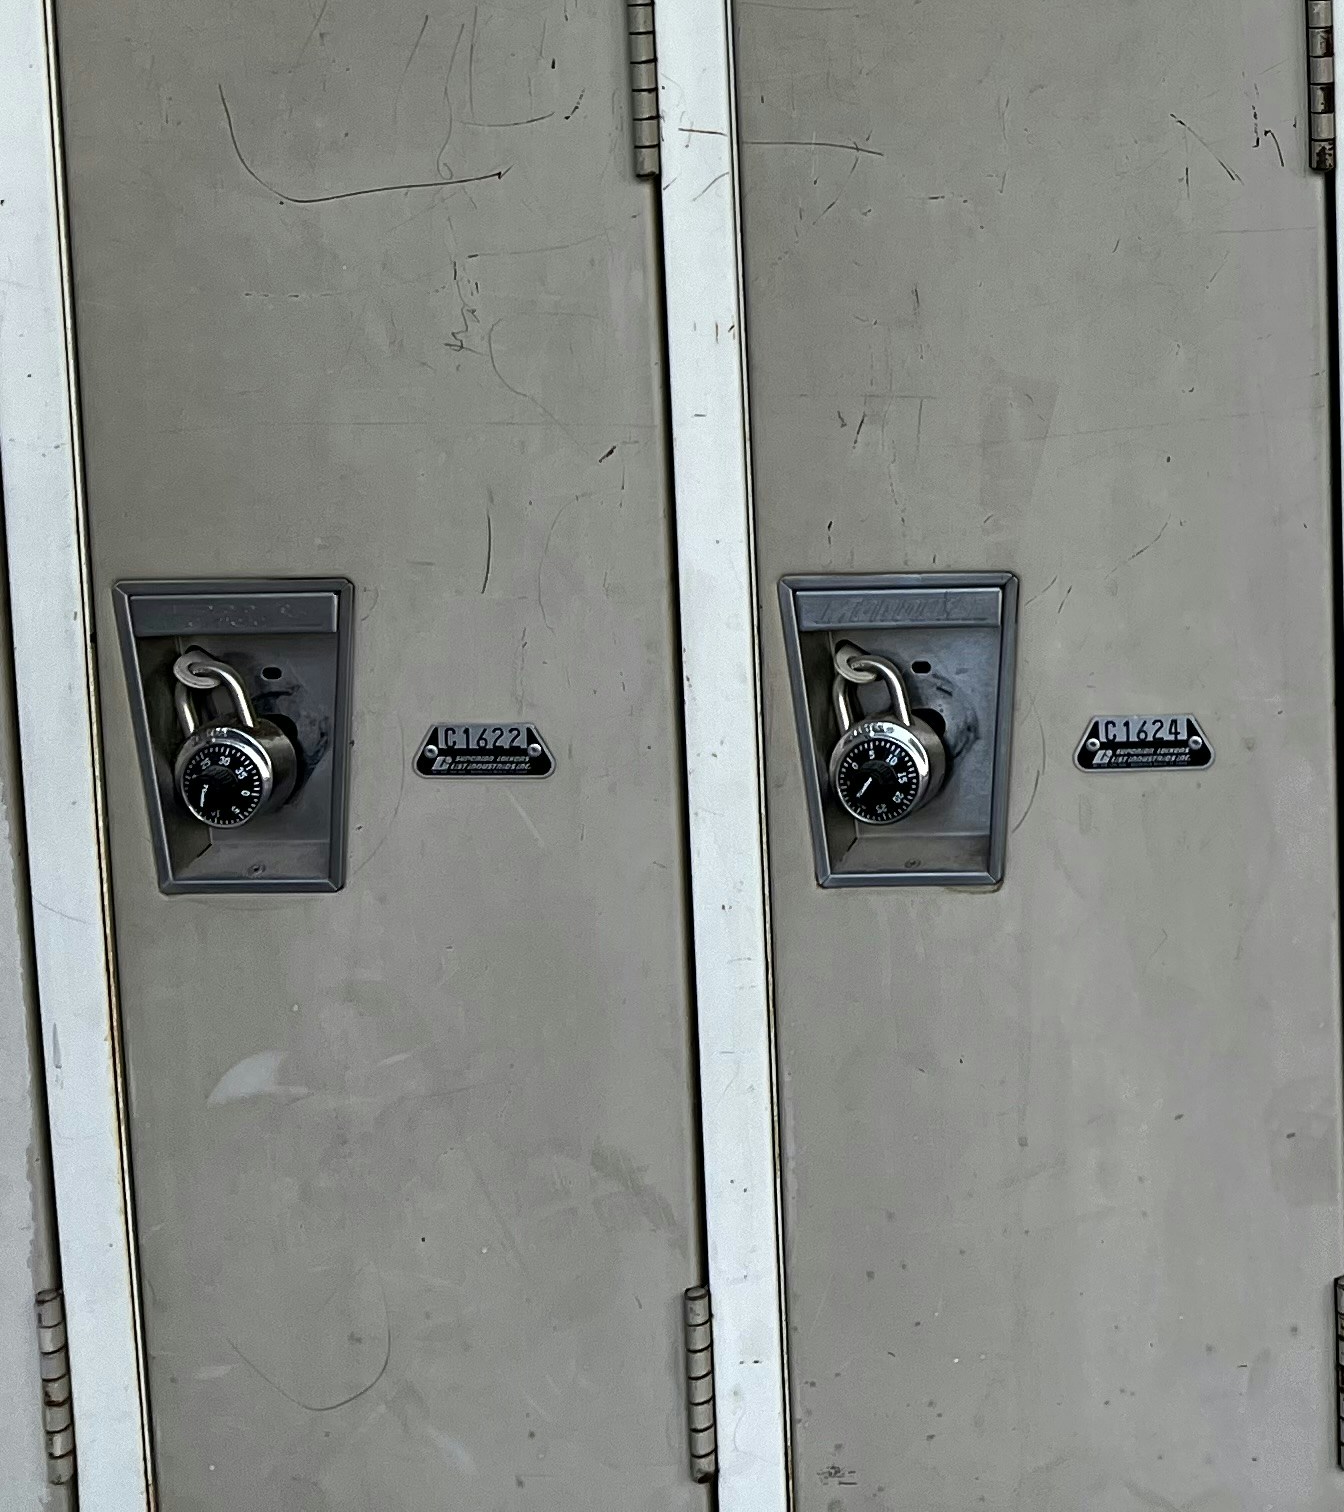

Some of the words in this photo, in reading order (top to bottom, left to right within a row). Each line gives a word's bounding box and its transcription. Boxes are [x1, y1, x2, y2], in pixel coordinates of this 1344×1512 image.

[1105, 719, 1180, 741] C1624
[444, 728, 520, 748] C1622
[869, 750, 875, 759] 5
[886, 753, 898, 765] 10
[220, 756, 230, 766] 30
[236, 767, 248, 778] 35
[898, 772, 907, 783] 15
